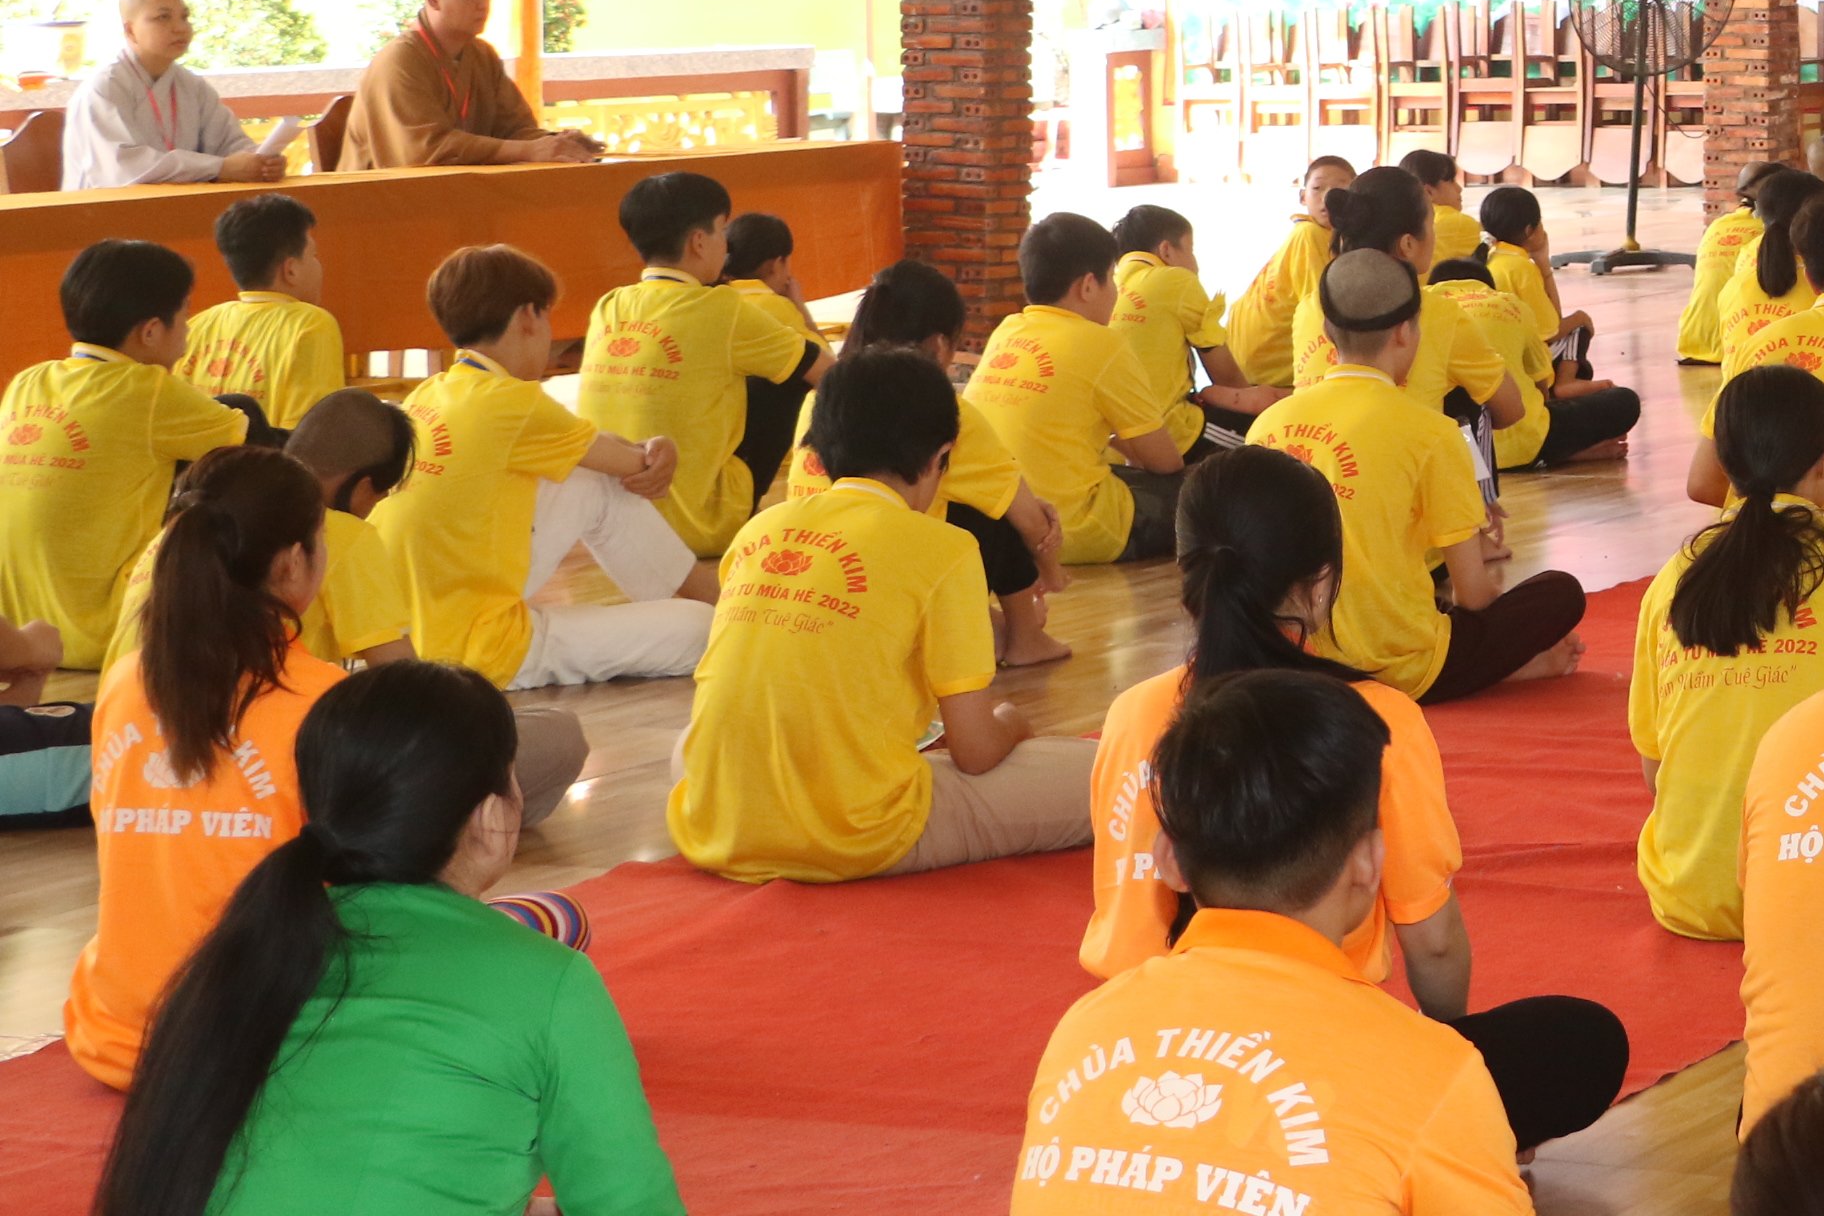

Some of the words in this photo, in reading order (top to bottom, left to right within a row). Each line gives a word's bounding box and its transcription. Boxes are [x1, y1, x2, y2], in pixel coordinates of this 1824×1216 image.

[658, 335, 683, 364] KIM
[1035, 351, 1055, 378] KIM
[1019, 379, 1049, 394] 2022
[64, 414, 90, 452] KIM
[432, 424, 452, 457] KIM
[1284, 421, 1338, 445] THIỀN
[1332, 441, 1359, 479] KIM
[49, 456, 87, 470] 2022
[782, 527, 848, 554] THIỀN
[838, 552, 868, 594] KIM
[739, 583, 754, 596] TU
[757, 583, 789, 600] MÙA
[793, 587, 815, 603] HÈ
[817, 594, 861, 620] 2022
[1774, 638, 1818, 656] 2022
[233, 739, 277, 799] KIM
[114, 801, 192, 834] PHÁP
[201, 807, 273, 839] VIÊN
[1778, 824, 1824, 864] HỘ
[1038, 1036, 1136, 1126] CHÙA
[1156, 1027, 1286, 1084] THIỀN
[1266, 1081, 1330, 1167] KIM
[1021, 1136, 1061, 1187] HỘ
[1063, 1145, 1184, 1193] PHÁP
[1195, 1170, 1313, 1216] VIÊN
